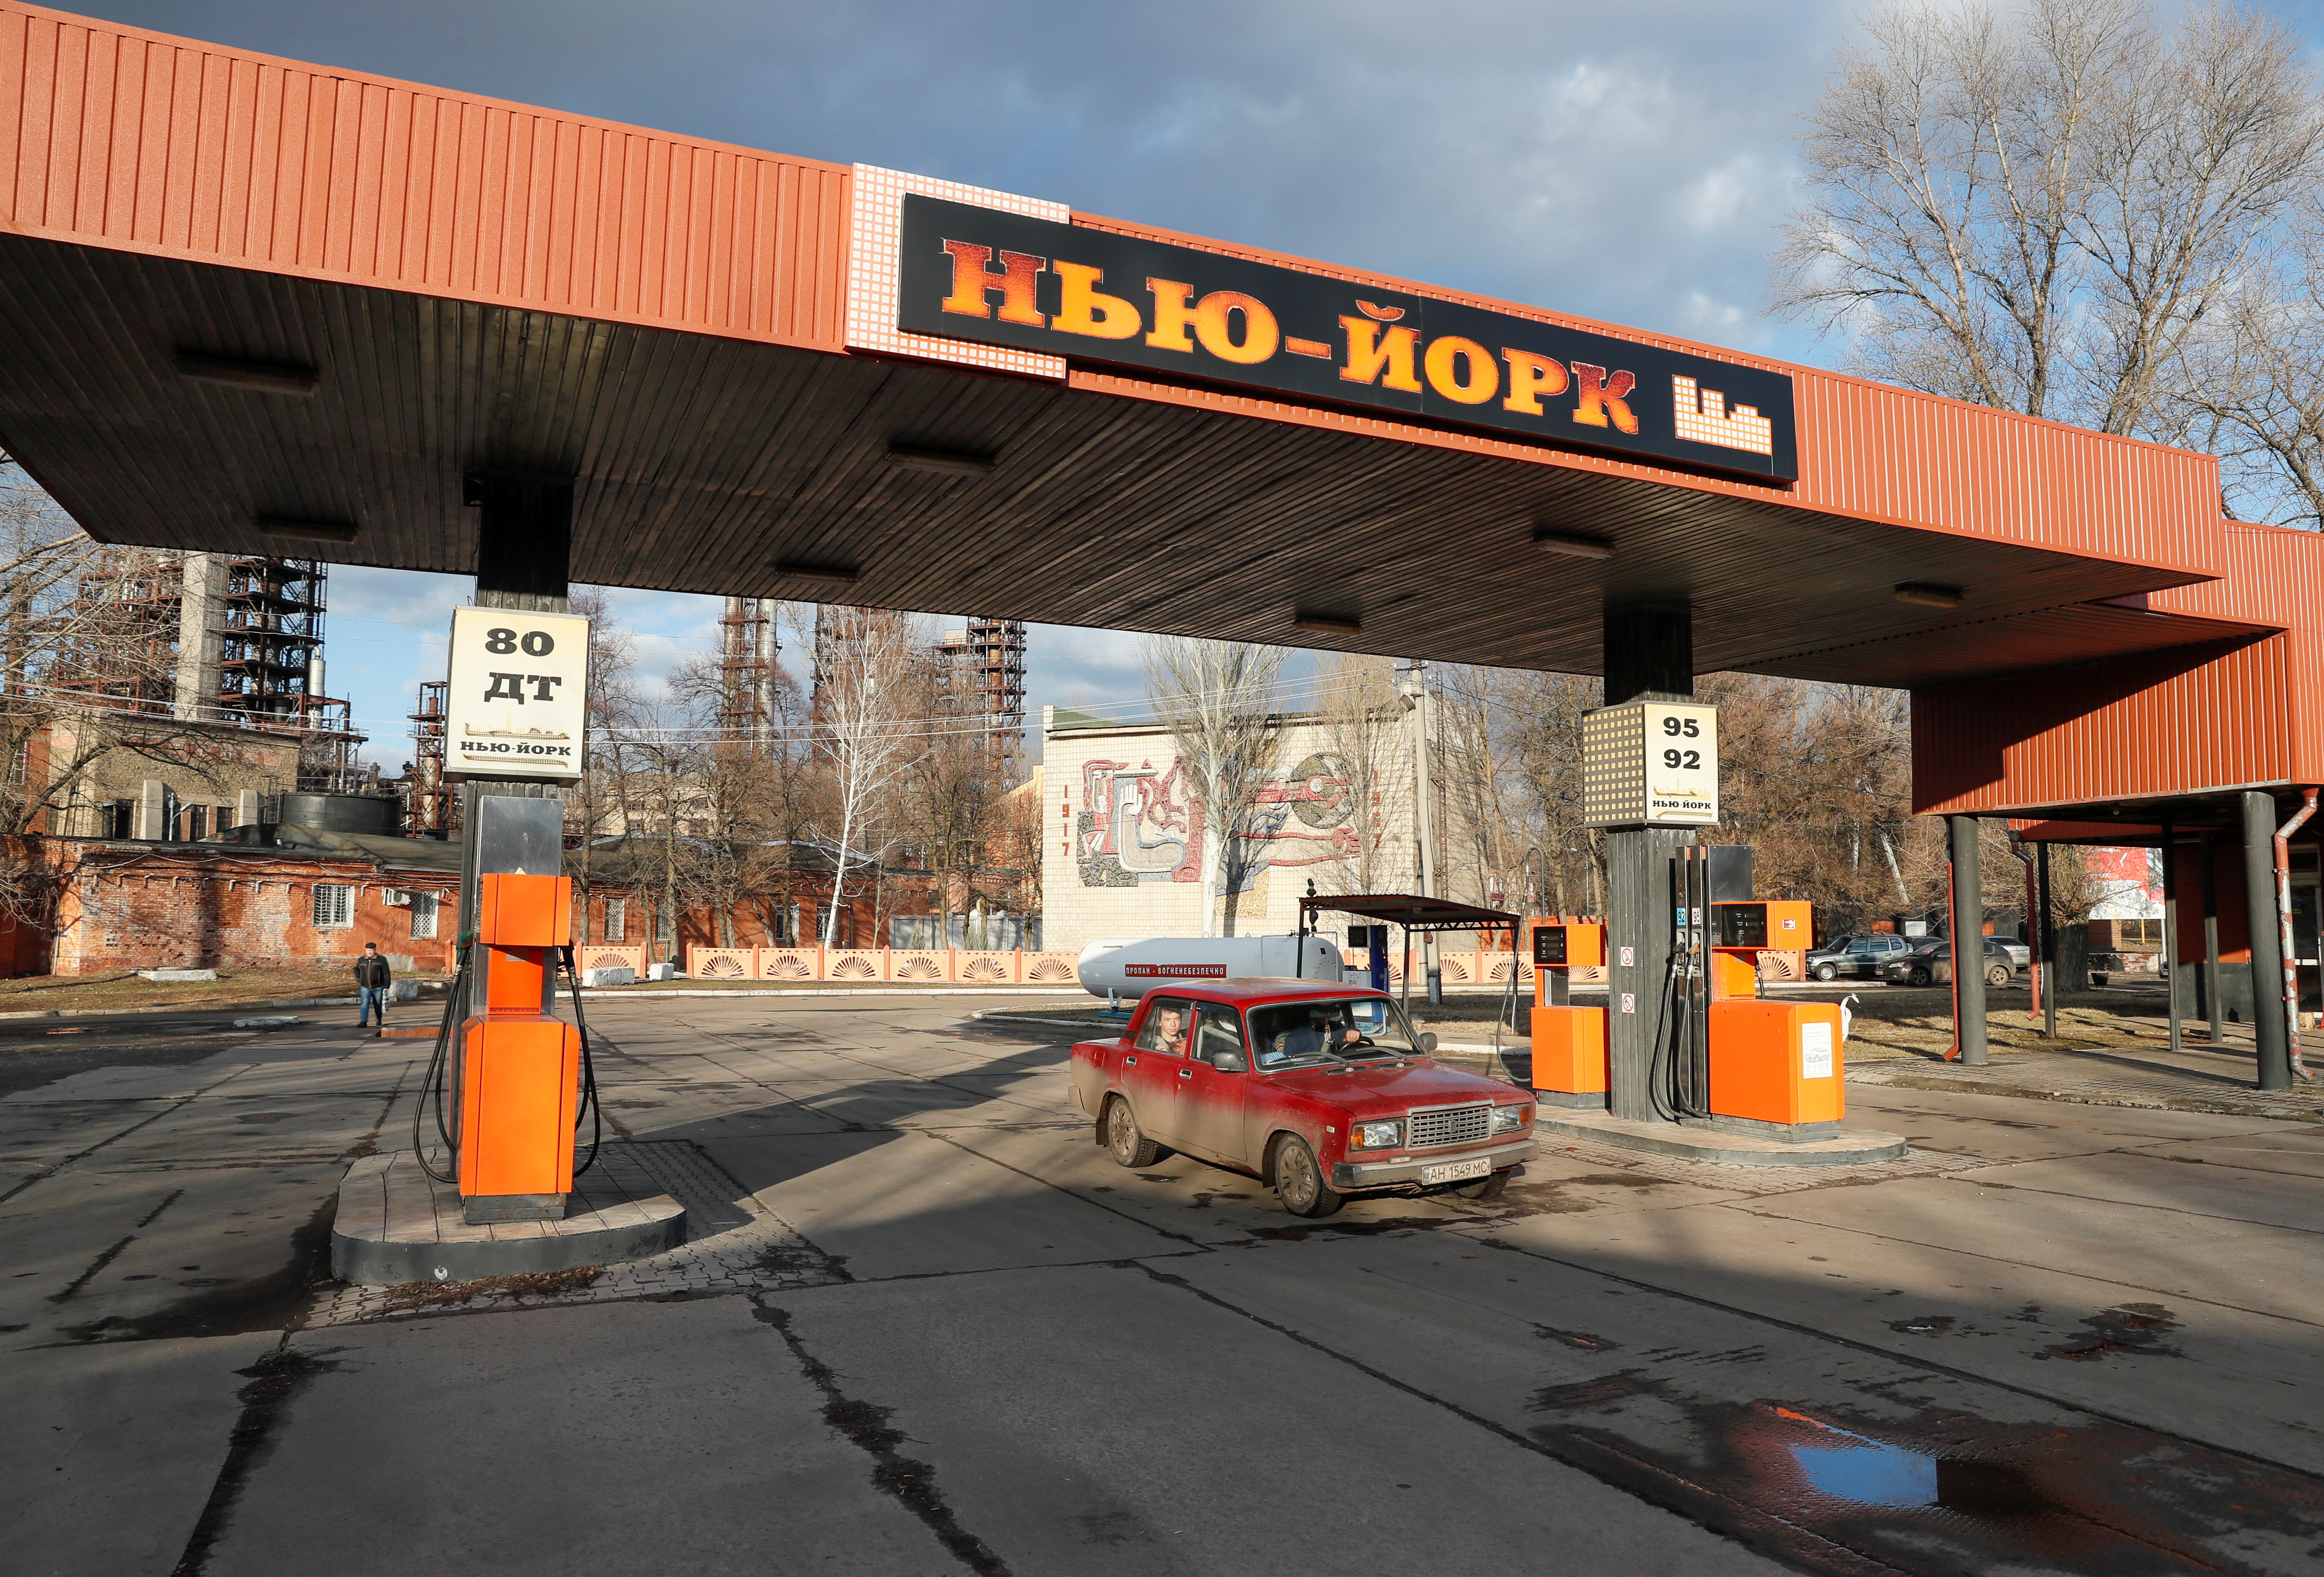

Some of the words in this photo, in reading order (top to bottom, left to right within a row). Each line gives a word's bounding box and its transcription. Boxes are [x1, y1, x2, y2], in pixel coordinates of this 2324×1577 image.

[941, 237, 1639, 434] НЬЮ-ЙОРК
[485, 628, 554, 656] 80
[484, 672, 562, 705] ДТ
[1663, 717, 1699, 737] 95
[460, 741, 571, 756] НЬЮ-ЙОРК
[1663, 749, 1700, 769] 92
[1653, 800, 1711, 809] НЬЮ-ЙОРК
[1678, 911, 1685, 923] 92
[1694, 911, 1700, 923] 95
[1430, 1167, 1445, 1181] AH
[1449, 1164, 1470, 1178] 1549
